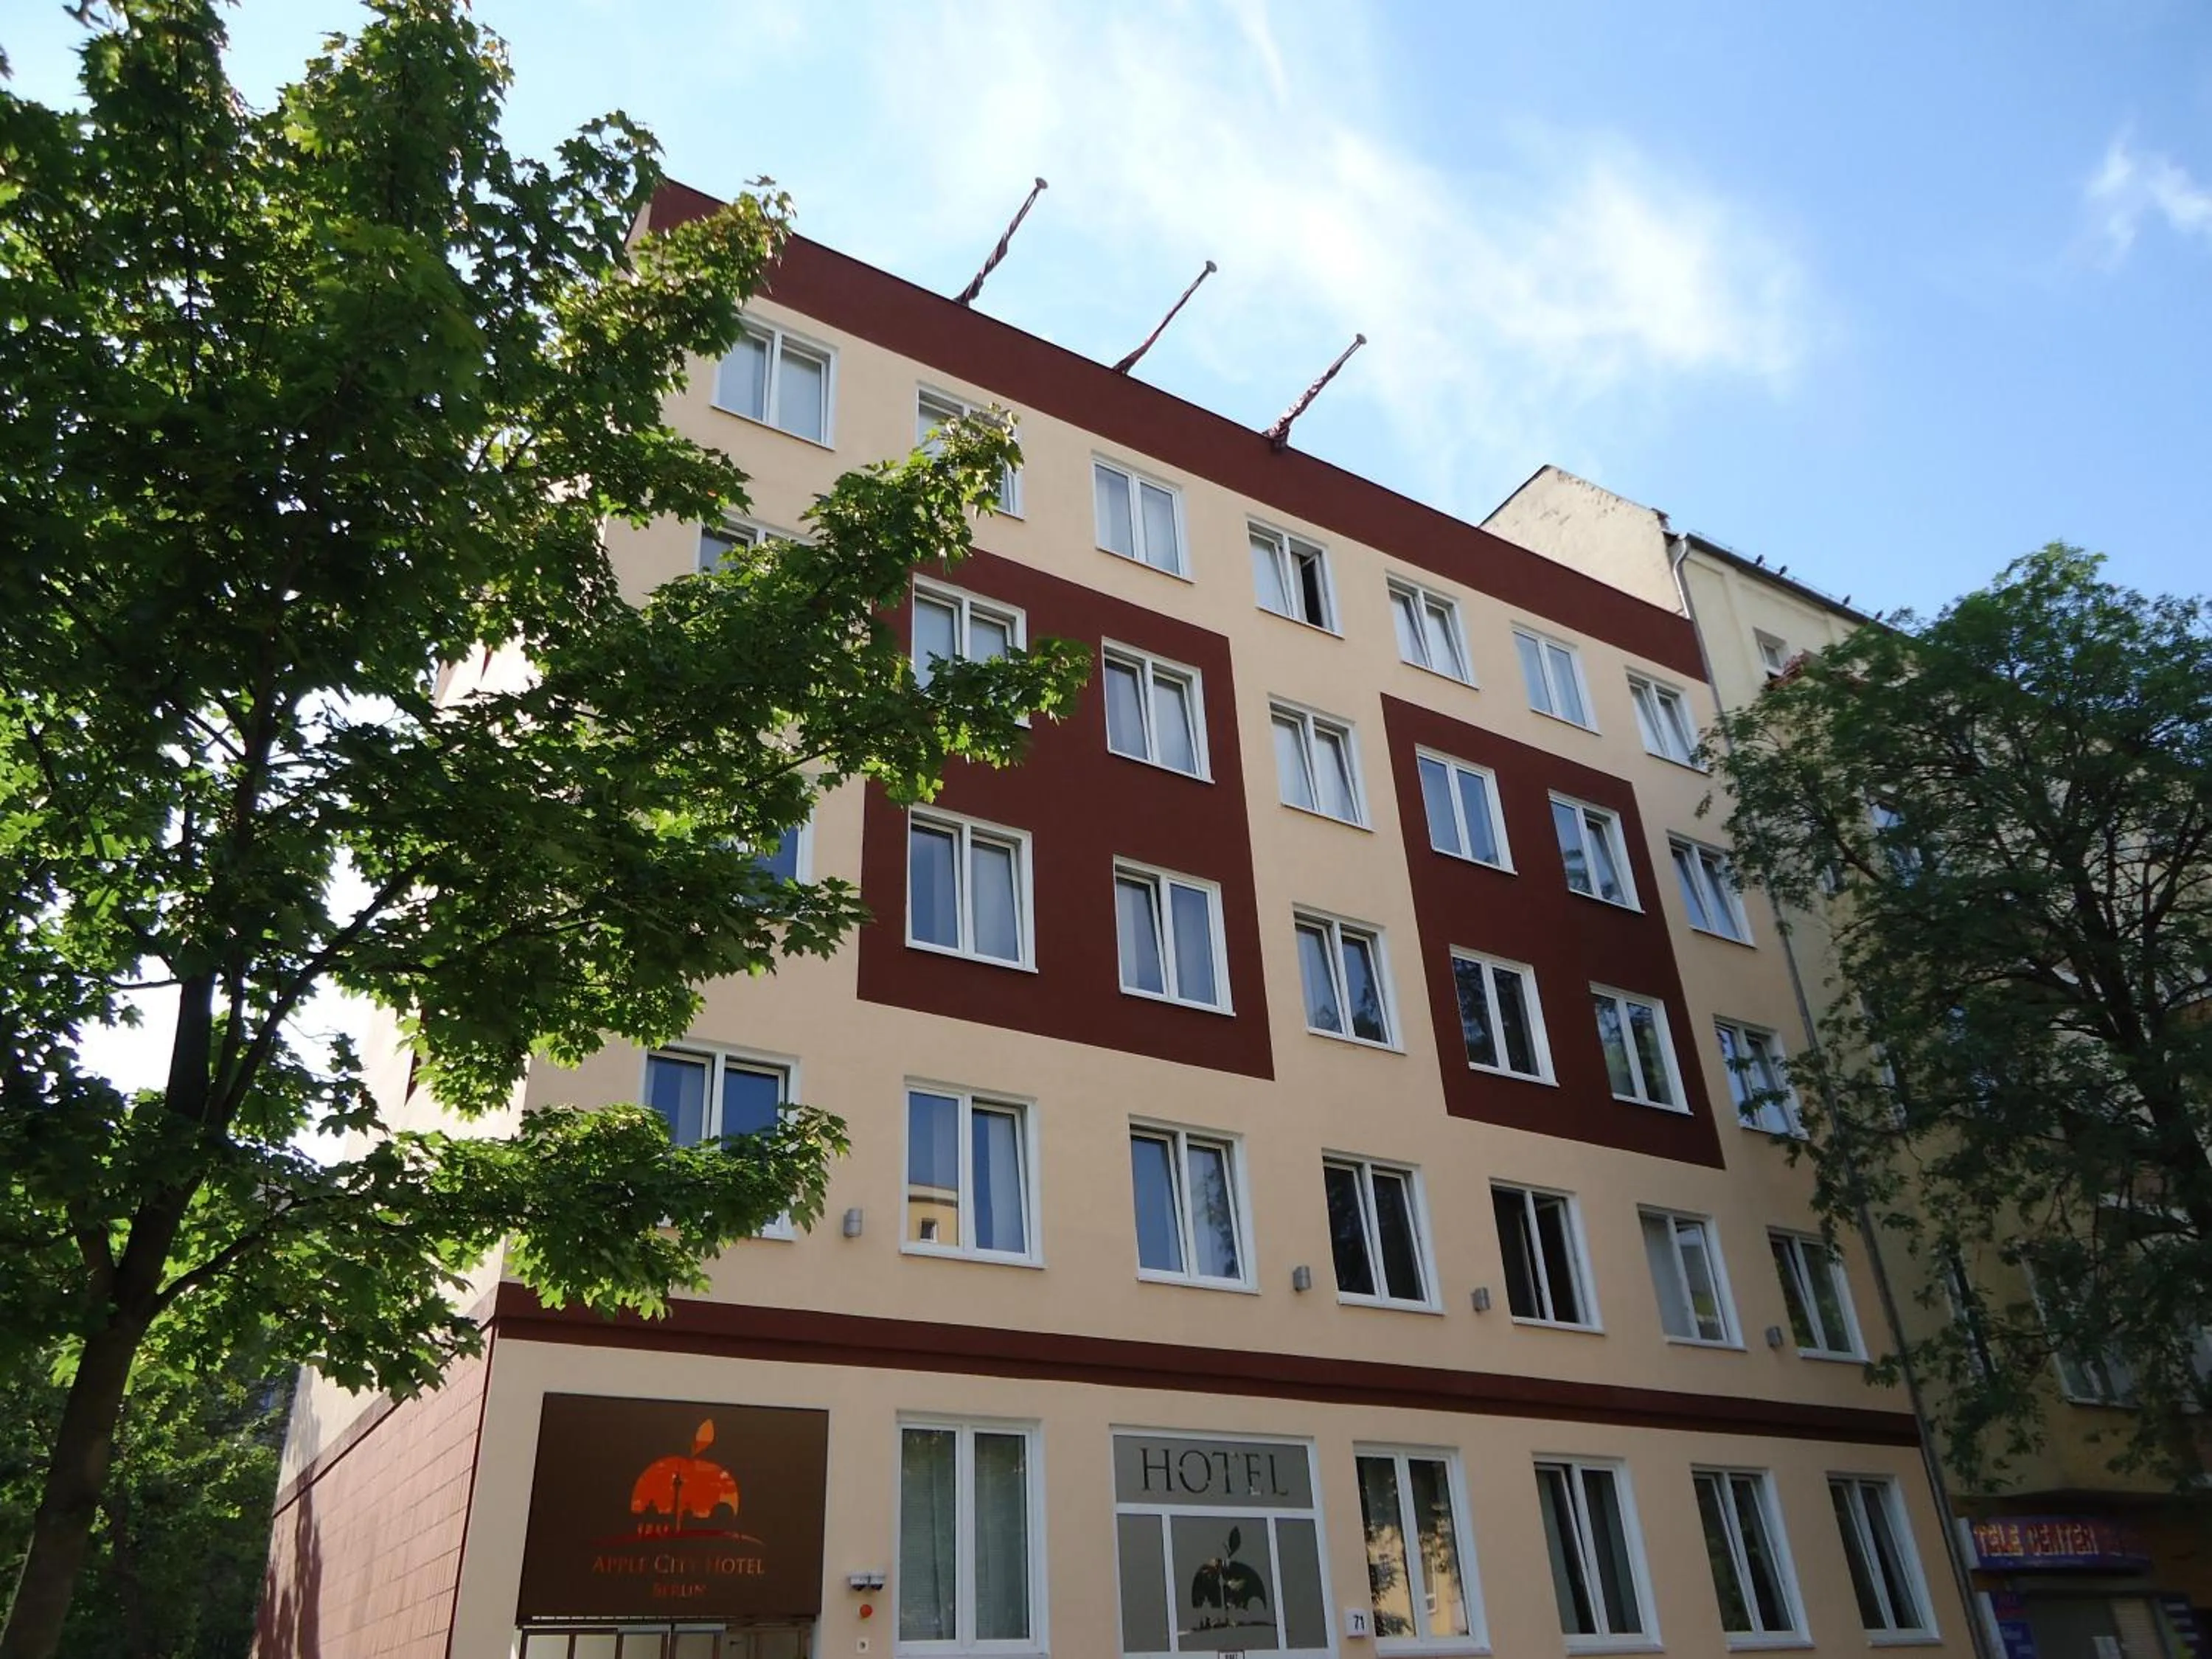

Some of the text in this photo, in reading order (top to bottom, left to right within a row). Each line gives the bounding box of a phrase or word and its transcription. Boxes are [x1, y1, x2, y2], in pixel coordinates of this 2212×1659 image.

[1141, 1447, 1289, 1497] HOTEL
[705, 1556, 765, 1575] HOTEL
[1353, 1614, 1366, 1631] 71
